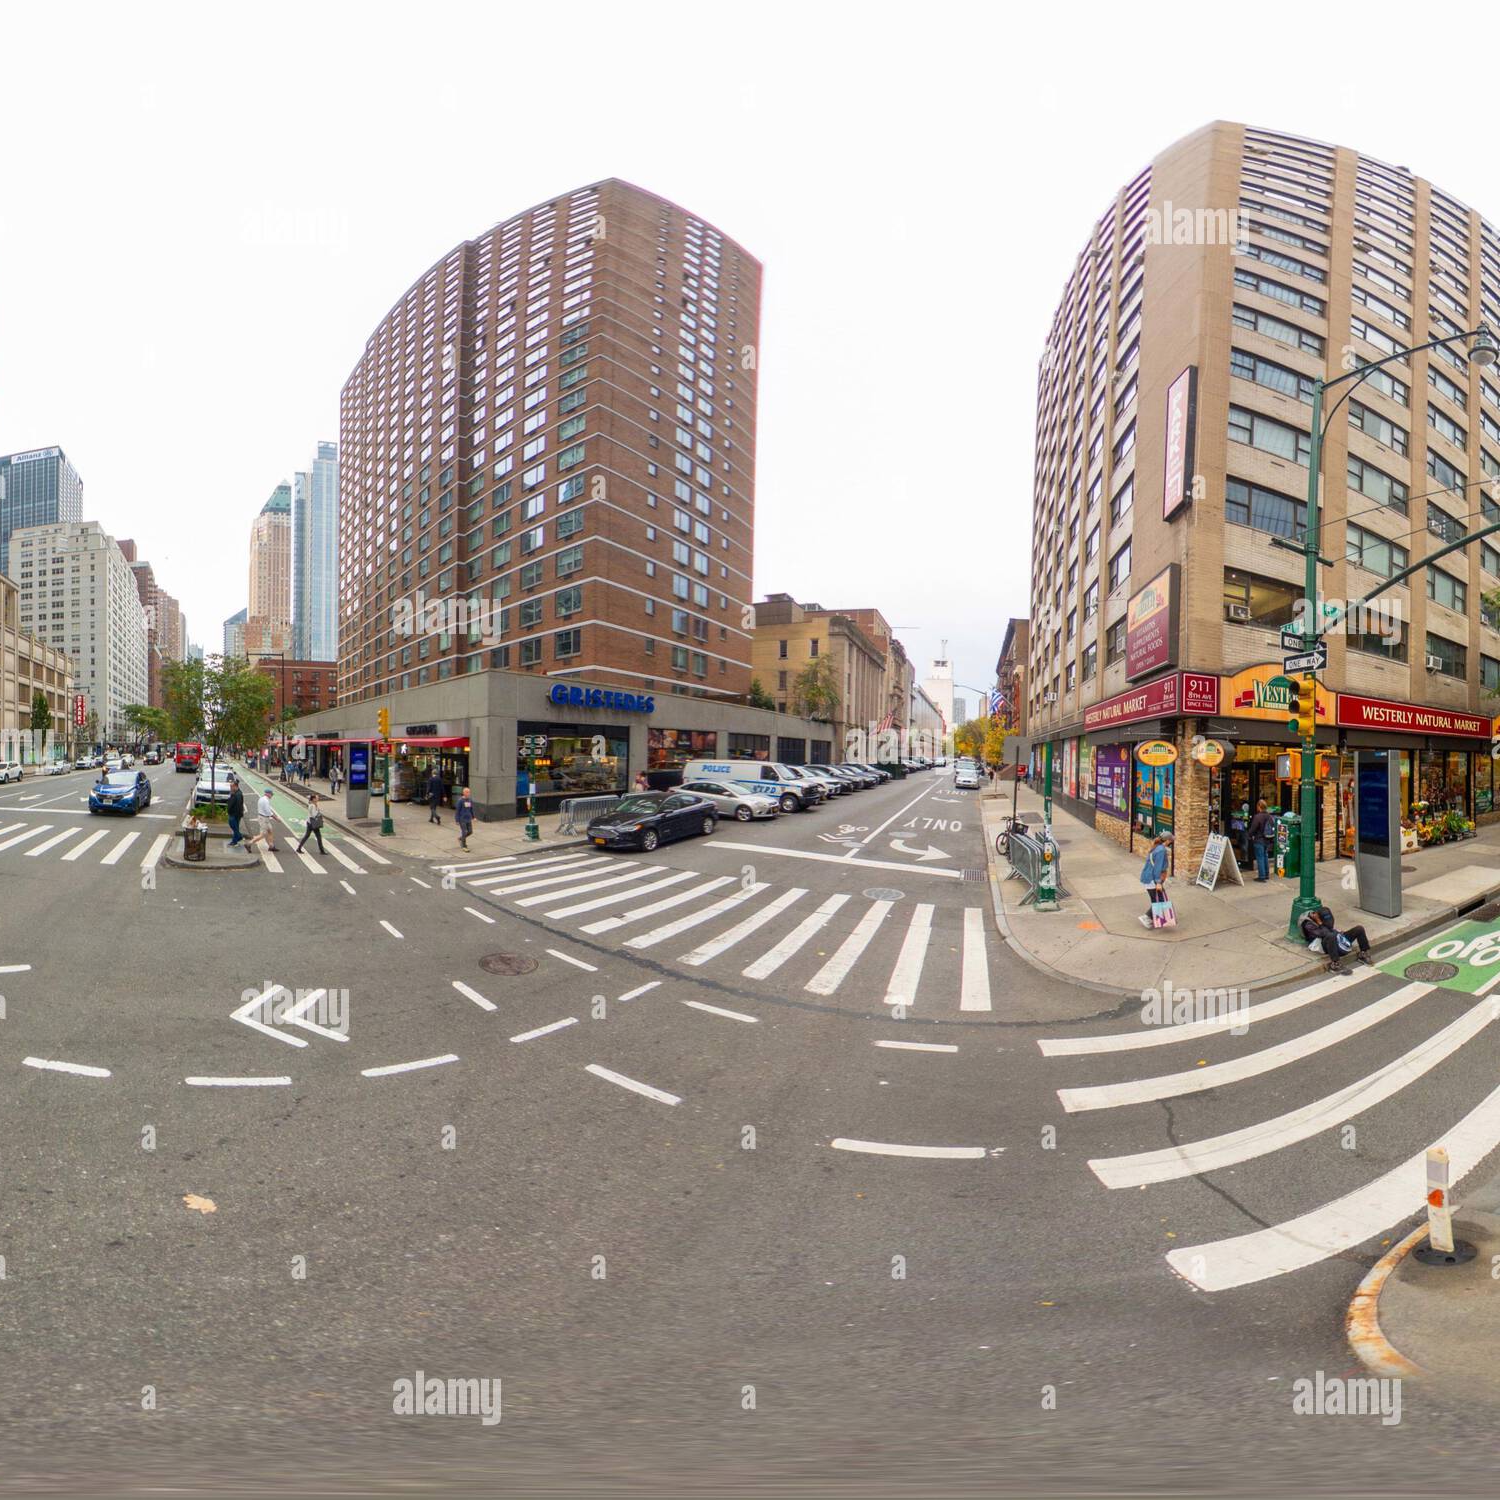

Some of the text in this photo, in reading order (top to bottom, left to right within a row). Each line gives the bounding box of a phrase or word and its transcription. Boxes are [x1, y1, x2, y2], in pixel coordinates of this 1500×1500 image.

[1130, 637, 1164, 662] NATURAL FOODS
[1288, 639, 1302, 648] ONE
[1289, 656, 1320, 668] ONE WAY
[1163, 680, 1174, 694] 911
[1189, 679, 1210, 692] 911
[551, 684, 656, 714] GRISTEDES
[1187, 691, 1201, 699] 8TH
[1102, 702, 1123, 720] NATURAL
[1123, 695, 1147, 713] MARKET
[1362, 705, 1481, 732] WESTERLY NATURAL MARKET
[701, 764, 732, 774] POLICE
[751, 784, 777, 795] NYPD
[902, 816, 963, 832] ONLY
